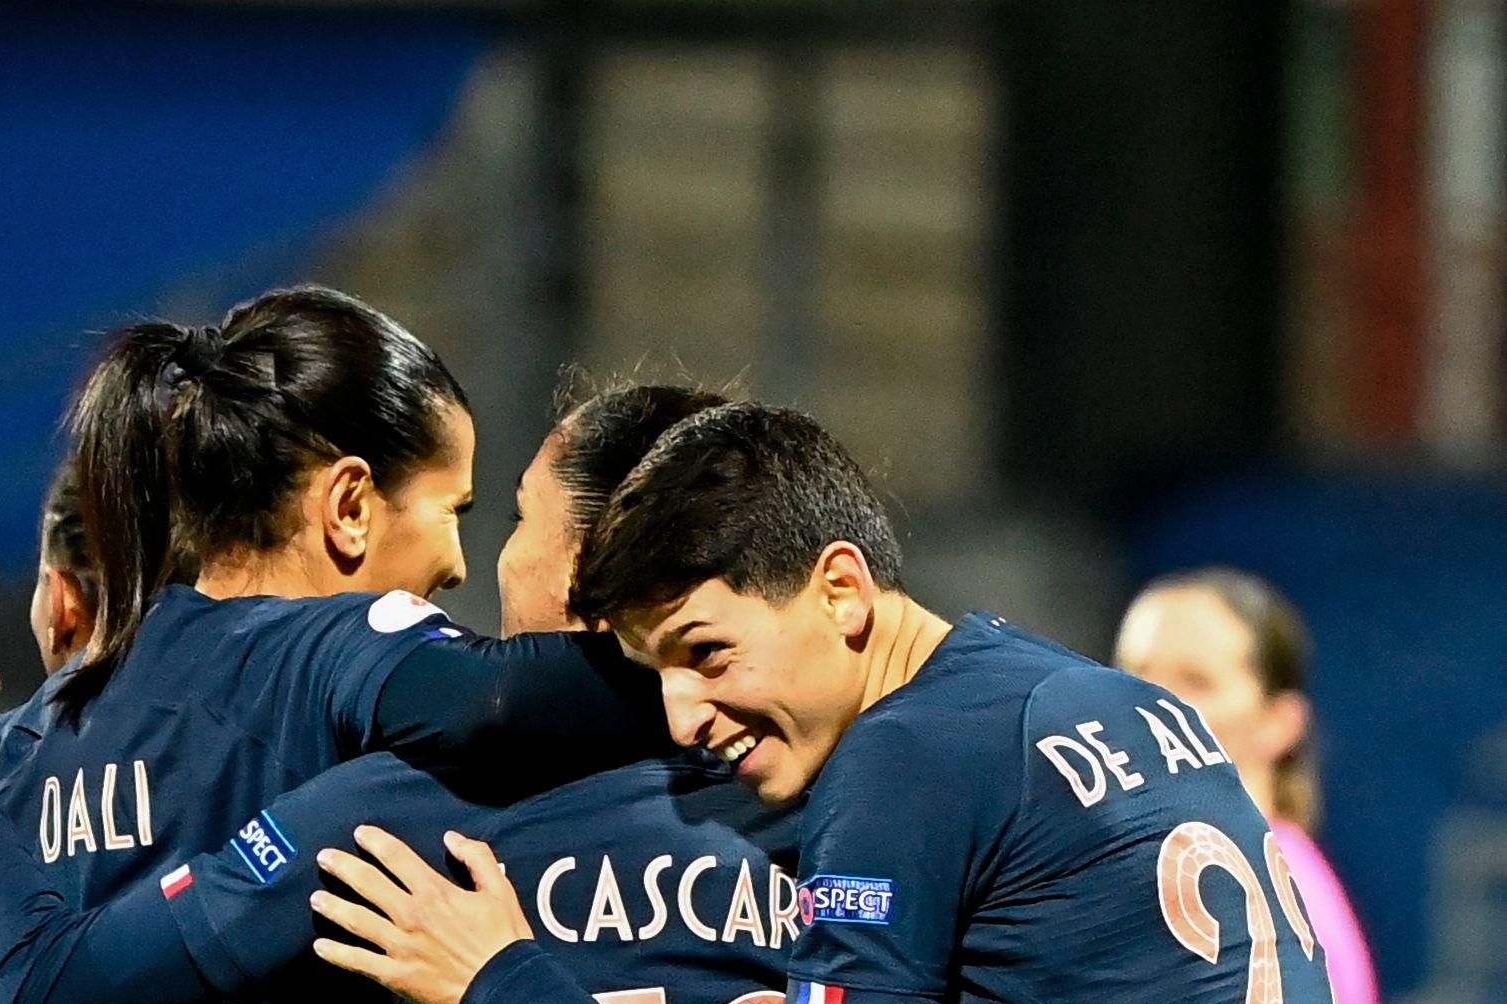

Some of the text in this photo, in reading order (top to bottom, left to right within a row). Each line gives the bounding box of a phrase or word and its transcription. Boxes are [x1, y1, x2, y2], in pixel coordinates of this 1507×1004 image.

[1036, 699, 1233, 808] DE AL
[40, 760, 153, 863] DALI
[239, 820, 287, 872] SPECT
[537, 854, 800, 949] CASCAR
[814, 887, 893, 912] SPECT
